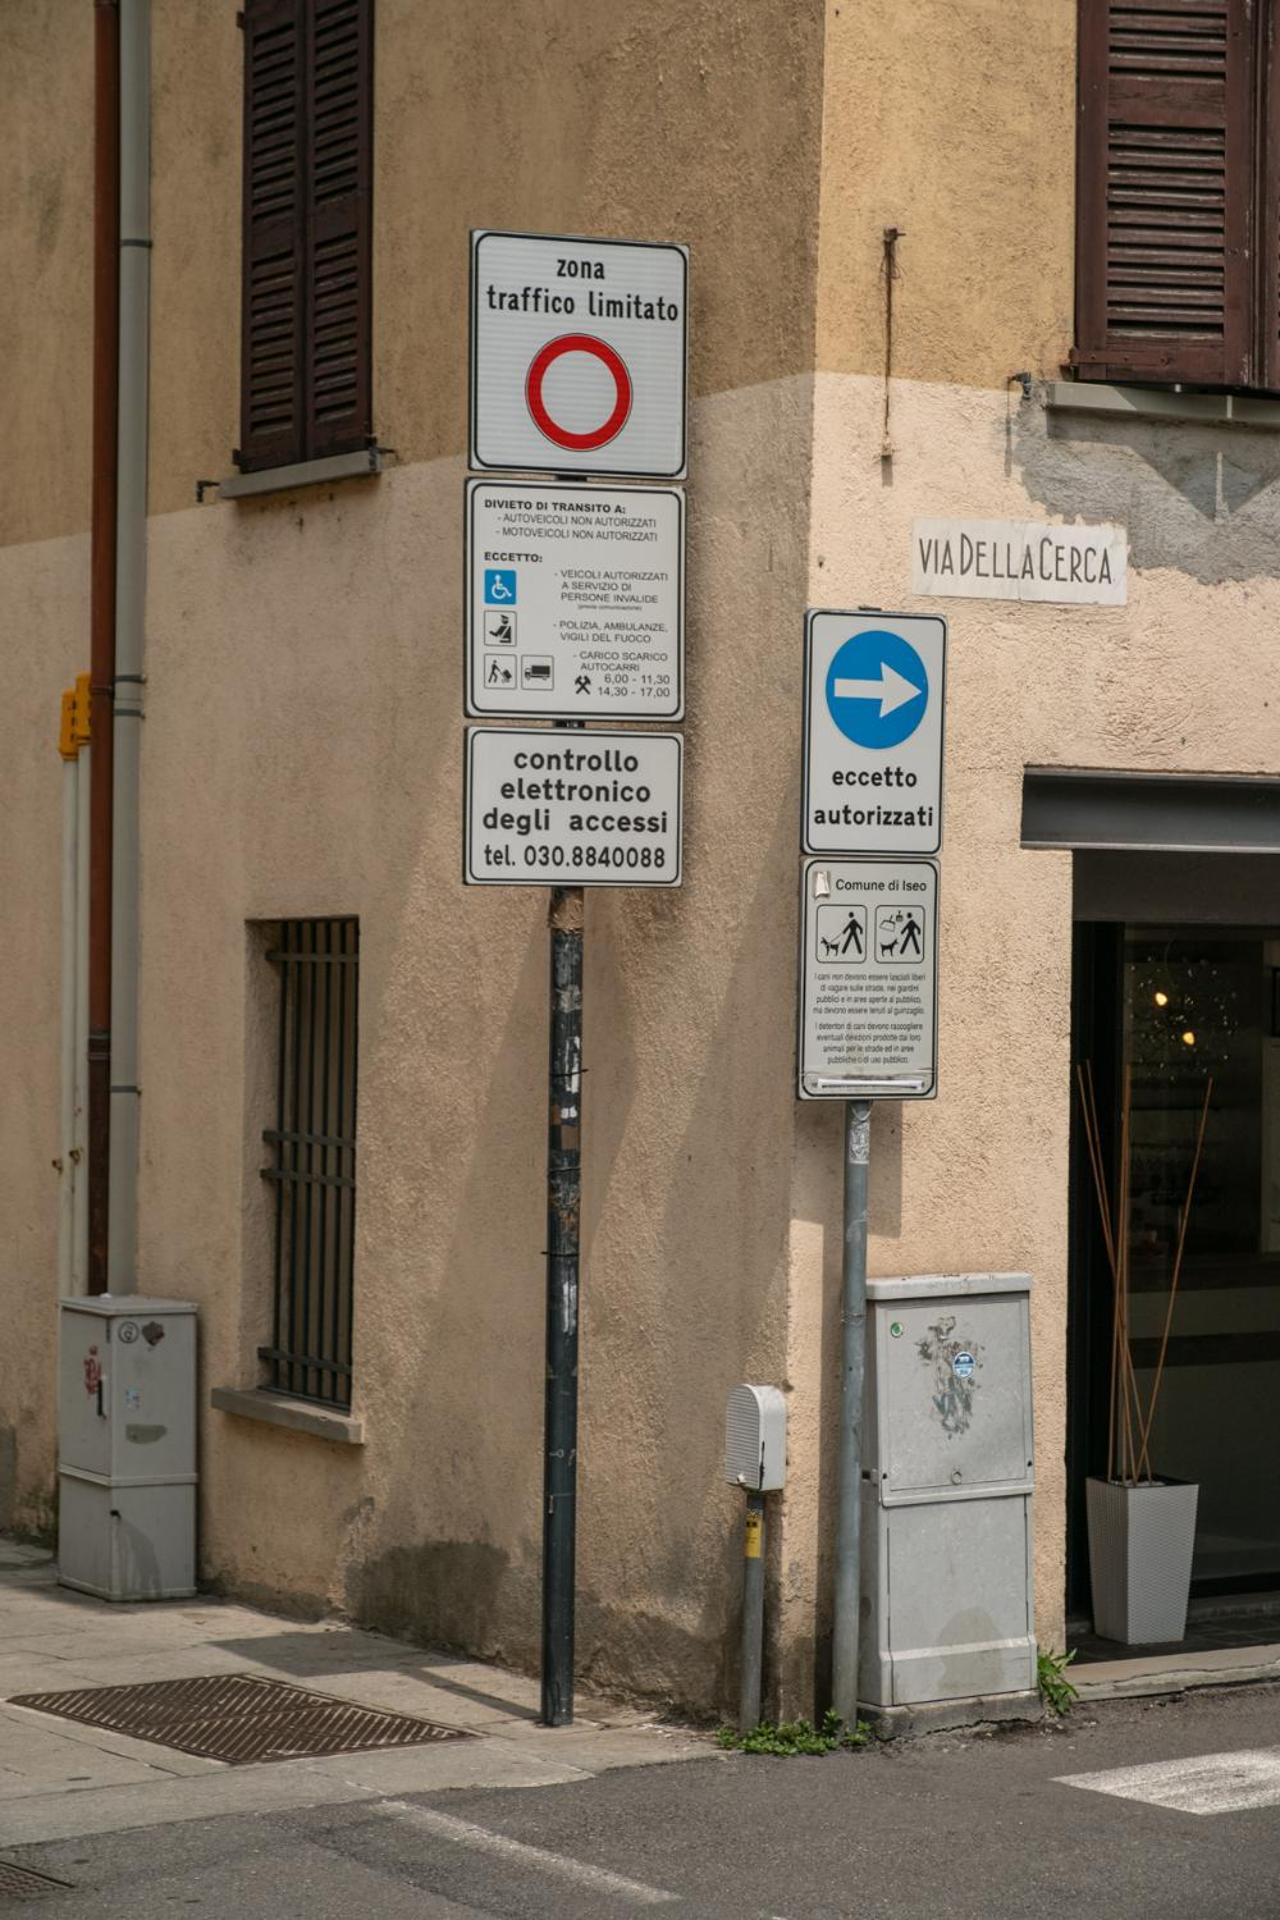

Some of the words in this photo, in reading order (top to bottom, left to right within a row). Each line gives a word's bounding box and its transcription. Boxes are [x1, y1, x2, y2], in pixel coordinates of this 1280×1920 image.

[557, 259, 605, 280] zona
[487, 285, 575, 314] traffico
[589, 291, 678, 321] limitato
[485, 499, 532, 510] DIVIETO
[536, 501, 548, 510] DI
[553, 502, 611, 513] TRANSITO
[614, 504, 626, 514] A:
[503, 514, 568, 525] AUTOVEICOLI
[571, 516, 593, 526] NON
[595, 517, 656, 528] AUTORIZZATI
[502, 527, 570, 539] MOTOVEICOLI
[573, 530, 593, 539] NON
[596, 531, 657, 542] AUTORIZZATI
[484, 552, 543, 563] ECCETTO:
[919, 538, 954, 575] VIA
[560, 570, 601, 580] VEICOLI
[603, 571, 668, 581] AUTORIZZATI
[562, 582, 568, 590] A
[572, 582, 618, 591] SERVIZIO
[621, 583, 632, 591] DI
[561, 592, 610, 602] PERSONE
[614, 594, 658, 603] INVALIDE
[560, 633, 589, 641] VIGILI
[592, 633, 611, 642] DEL
[614, 634, 651, 643] FUOCO
[580, 651, 619, 660] CARICO
[622, 652, 668, 661] SCARICO
[581, 662, 640, 671] AUTOCARRI
[514, 749, 639, 772] controllo
[832, 767, 917, 787] eccetto
[501, 778, 650, 802] elettronico
[483, 807, 550, 835] degli
[569, 811, 667, 833] accessi
[814, 805, 933, 826] autorizzati
[484, 844, 516, 866] tel.
[524, 845, 665, 868] 030.8840088
[836, 879, 885, 891] Comune
[888, 880, 899, 891] di
[903, 880, 926, 891] Iseo
